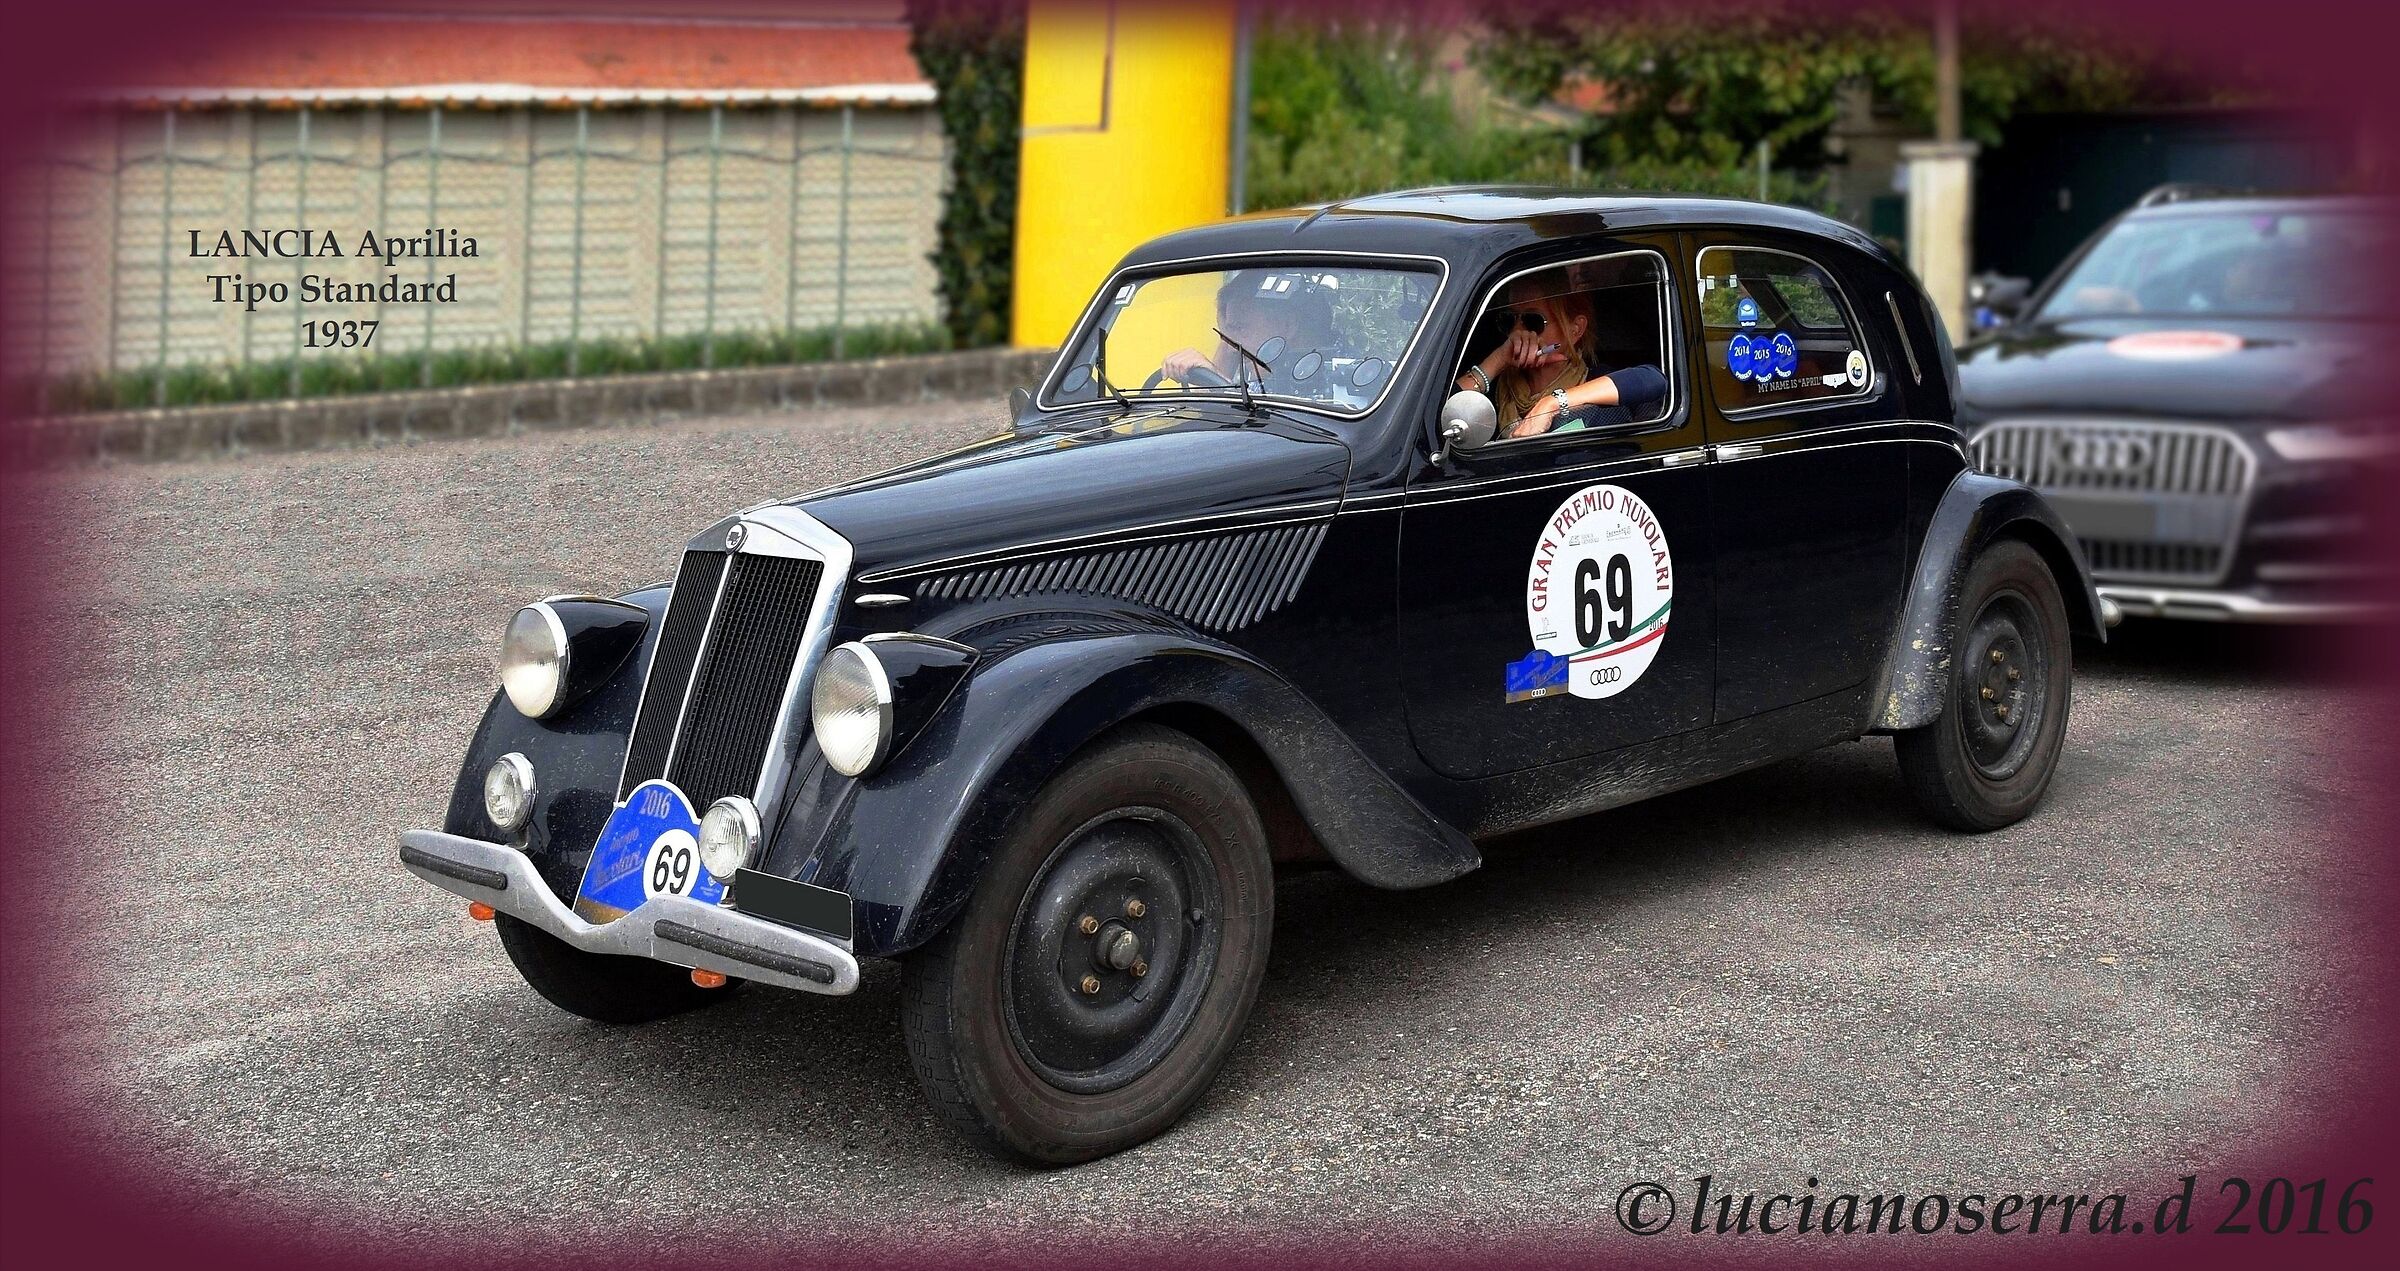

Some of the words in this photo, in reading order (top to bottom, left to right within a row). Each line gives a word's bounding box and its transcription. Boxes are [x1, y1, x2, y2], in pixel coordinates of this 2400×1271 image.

[1734, 345, 1750, 357] 2014
[1754, 349, 1770, 360] 2015
[1776, 343, 1792, 356] 2016
[1758, 383, 1770, 393] MY
[1770, 380, 1791, 391] NAME
[1791, 379, 1798, 389] IS
[1532, 538, 1558, 612] GRAN
[1553, 490, 1615, 538] PREMIO
[1620, 494, 1670, 591] NUVOLARI
[1574, 553, 1633, 648] 69
[1649, 618, 1664, 632] 2016
[639, 788, 673, 820] 2016
[653, 844, 691, 895] 69
